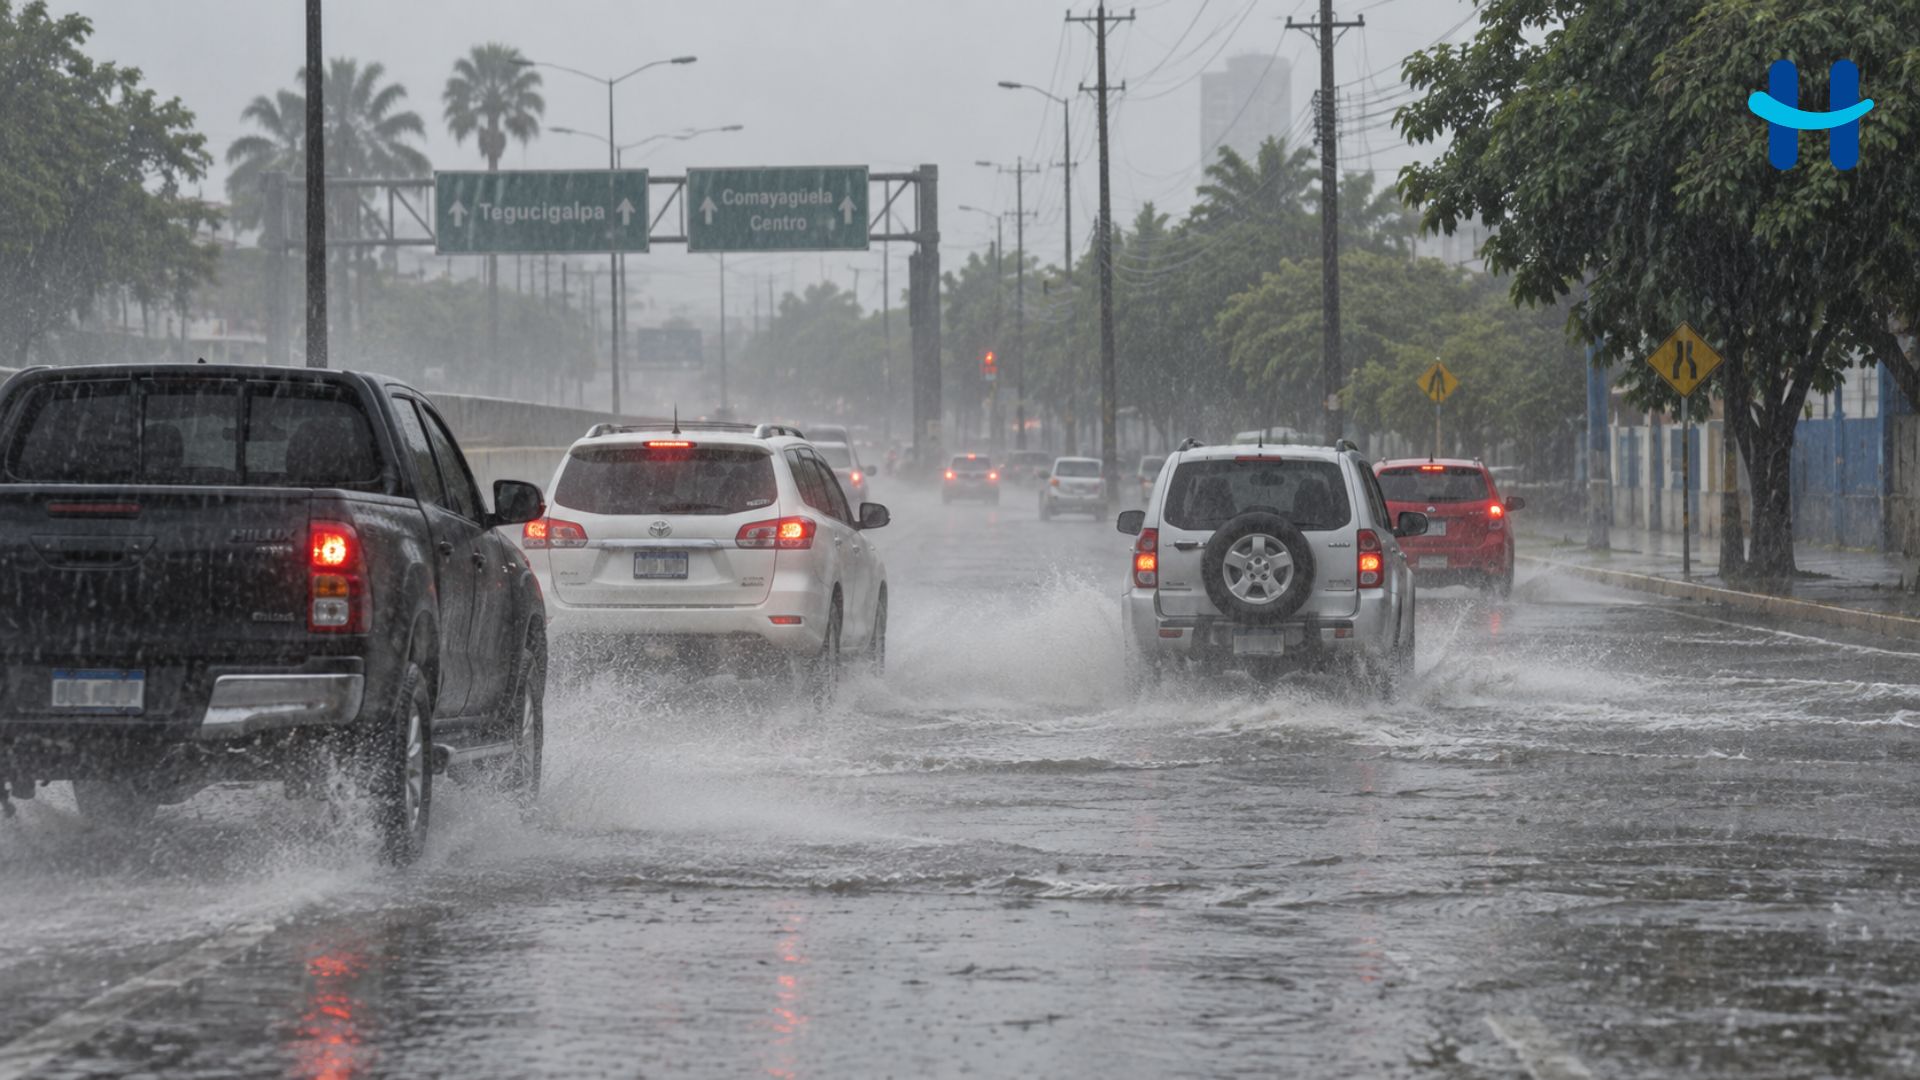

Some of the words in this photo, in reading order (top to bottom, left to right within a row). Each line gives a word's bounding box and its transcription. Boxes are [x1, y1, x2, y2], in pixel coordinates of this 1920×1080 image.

[722, 188, 833, 208] Comayagüela
[480, 201, 605, 225] Tegucigalpa
[750, 215, 807, 231] Centro
